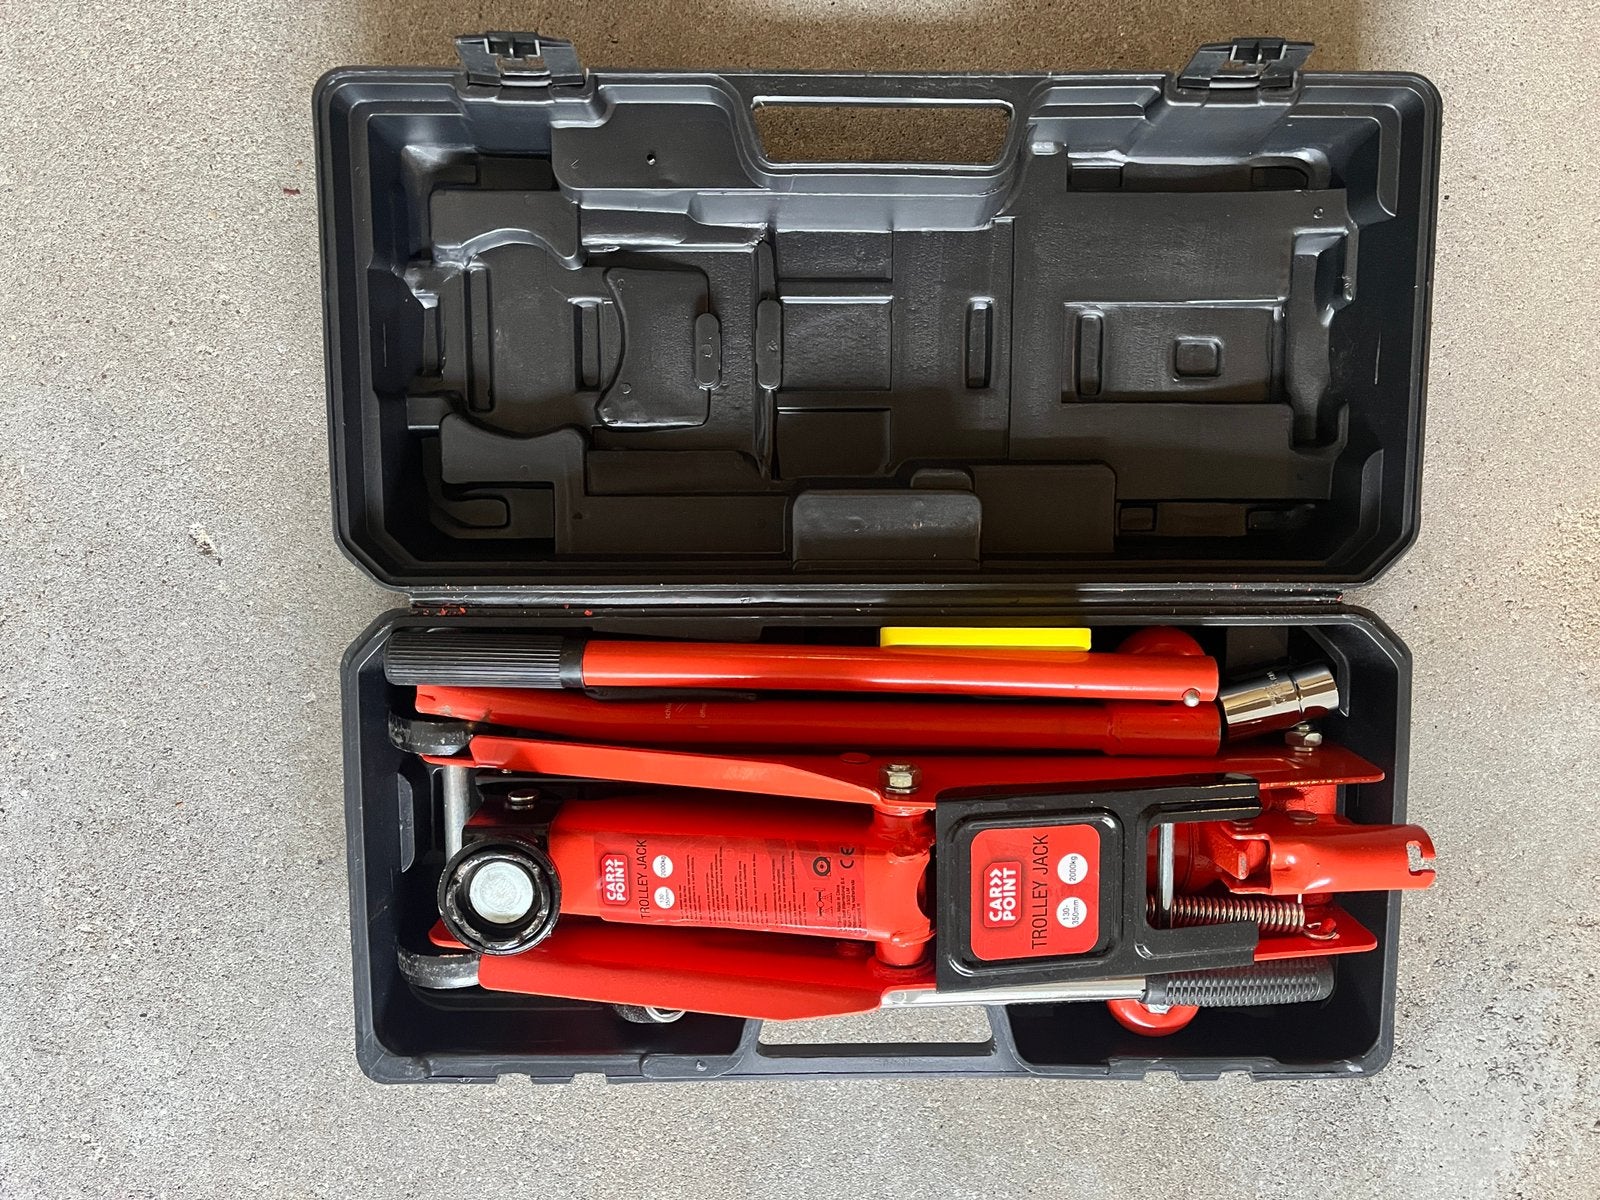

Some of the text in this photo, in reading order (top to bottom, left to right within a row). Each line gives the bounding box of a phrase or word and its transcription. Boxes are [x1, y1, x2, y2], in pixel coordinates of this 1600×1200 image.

[605, 873, 616, 900] CAR
[614, 859, 626, 901] POINT
[636, 840, 651, 919] TROLLEY JACK
[1069, 856, 1078, 881] 2000kg
[989, 887, 1002, 922] CAR
[1002, 867, 1016, 920] POINT
[1032, 834, 1048, 949] TROLLEY JACK
[1062, 905, 1070, 920] 130-
